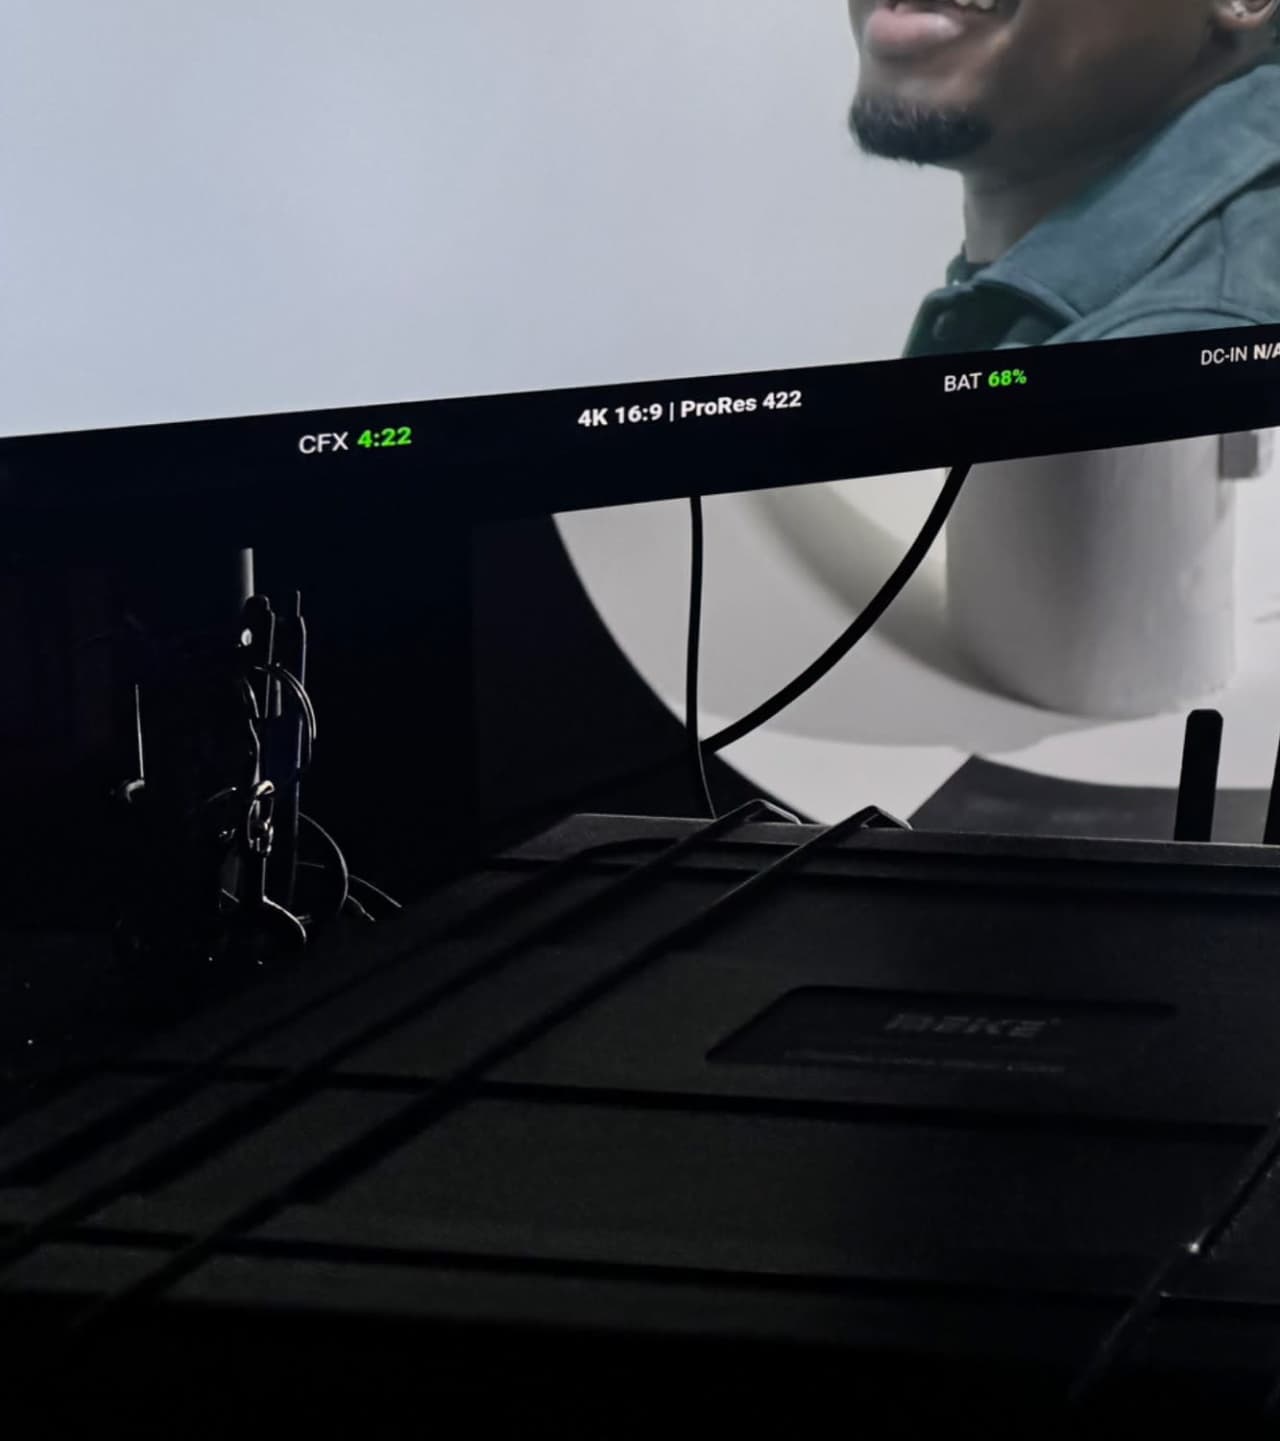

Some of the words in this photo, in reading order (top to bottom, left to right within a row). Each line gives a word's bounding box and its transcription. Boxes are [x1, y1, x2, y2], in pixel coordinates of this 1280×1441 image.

[1200, 345, 1248, 366] DC-IN
[943, 371, 983, 393] BAT
[987, 368, 1028, 389] 68%
[577, 407, 609, 428] 4K
[614, 402, 663, 425] 16:9
[680, 394, 758, 419] ProRes
[761, 389, 803, 410] 422
[298, 431, 349, 455] CFX
[356, 426, 412, 449] 4:22
